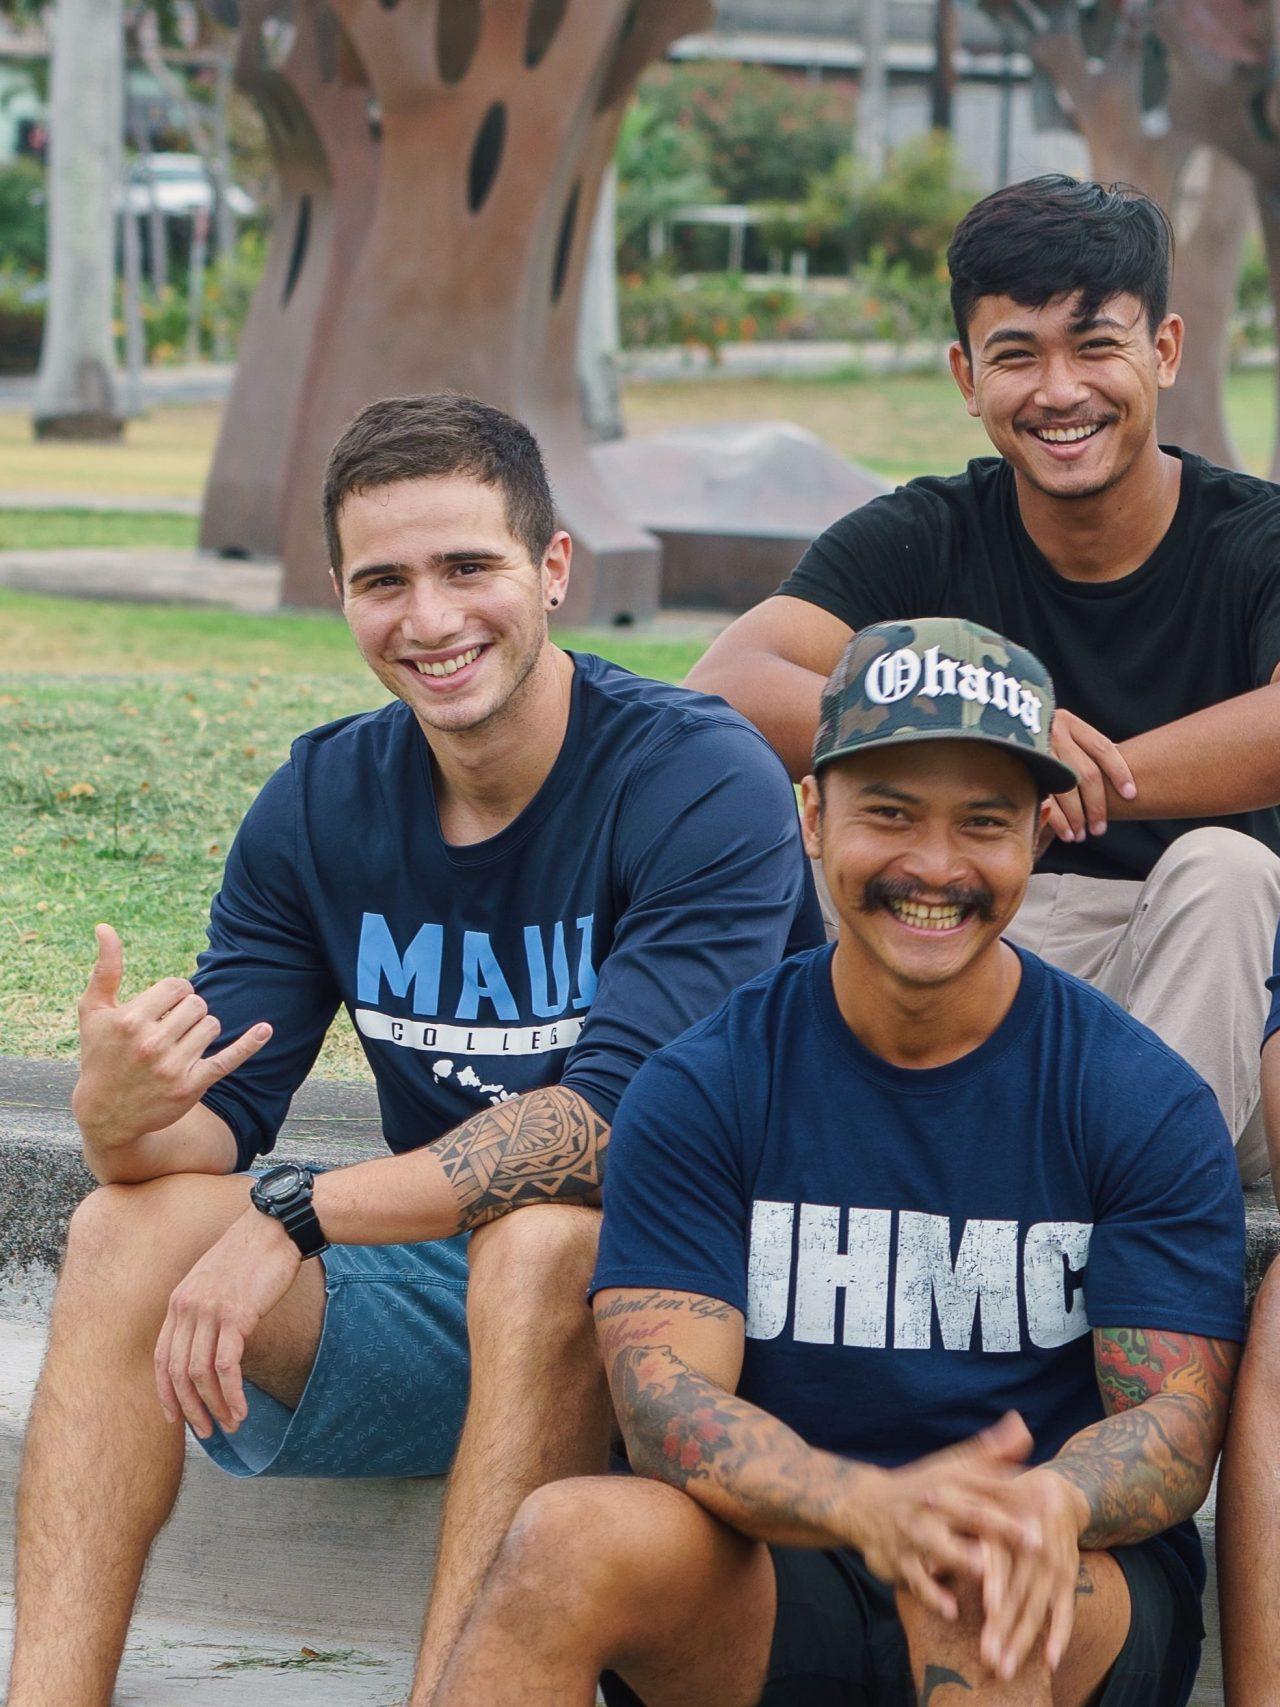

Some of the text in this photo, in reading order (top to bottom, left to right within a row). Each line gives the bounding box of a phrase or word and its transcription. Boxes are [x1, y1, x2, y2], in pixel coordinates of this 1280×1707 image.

[864, 644, 1042, 734] Ohana
[357, 911, 598, 1021] MAUI
[391, 1021, 585, 1051] COLLEG
